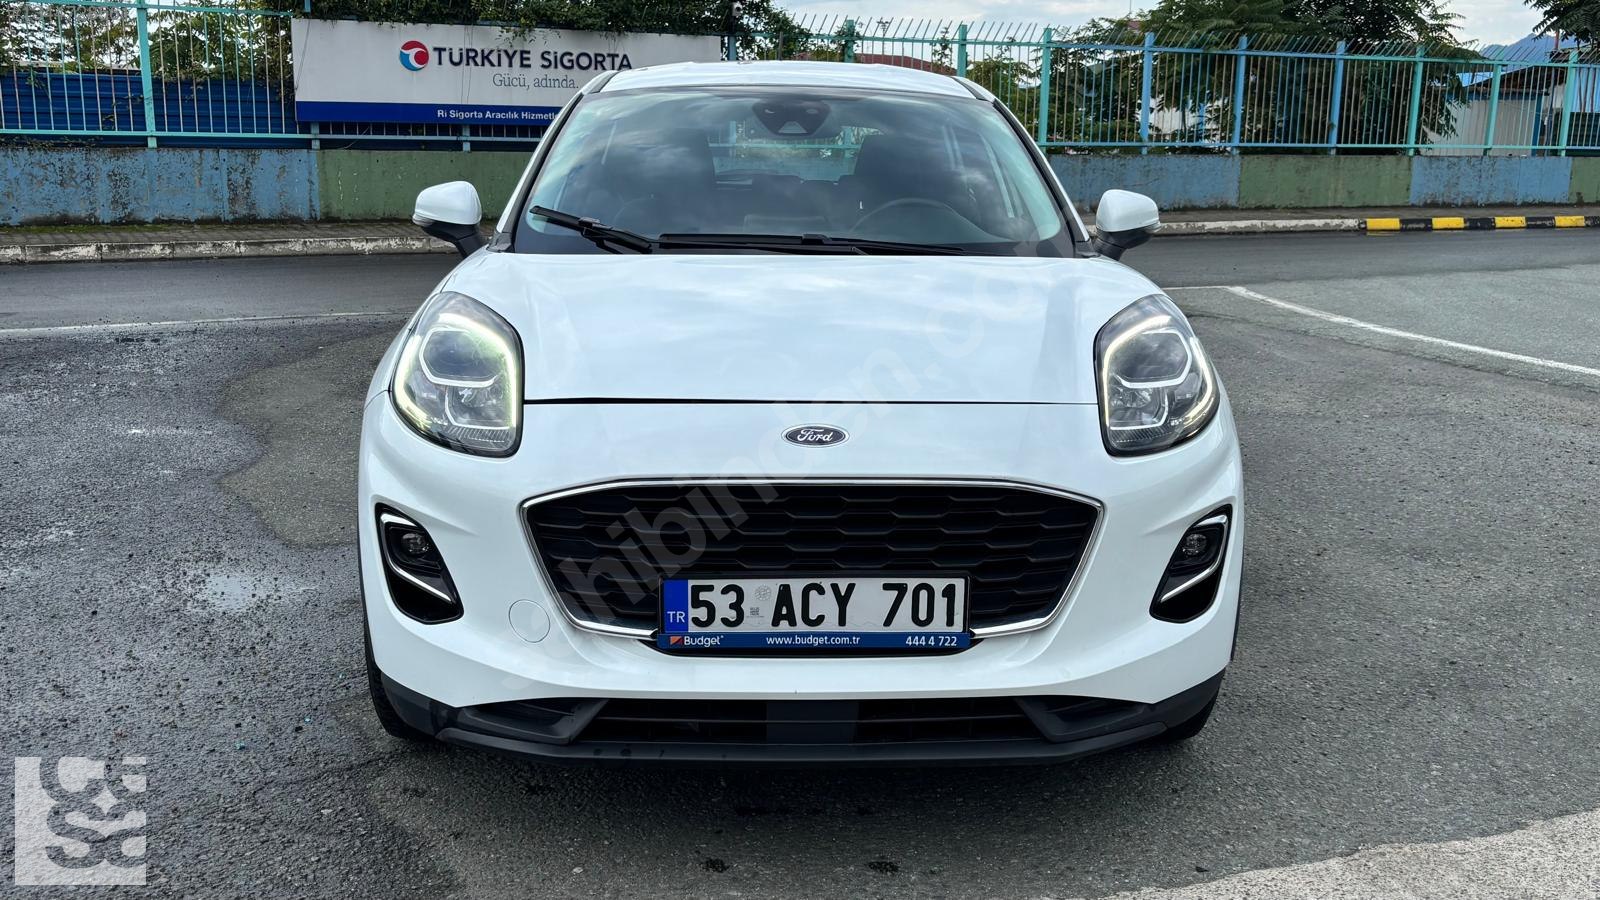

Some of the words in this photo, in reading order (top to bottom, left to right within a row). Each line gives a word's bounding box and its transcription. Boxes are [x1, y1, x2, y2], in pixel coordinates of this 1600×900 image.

[492, 73, 530, 91] Gücü,
[533, 74, 579, 89] adında.
[437, 109, 447, 118] Ri
[449, 109, 483, 120] Sigorta
[485, 111, 519, 119] Aracılık
[797, 428, 834, 442] Ford
[690, 584, 745, 628] 53
[771, 583, 856, 628] ACY
[882, 583, 957, 628] 701
[667, 611, 686, 623] TR
[684, 635, 721, 648] Budget
[766, 635, 861, 647] www.budget.com.tr
[905, 635, 926, 647] 444
[938, 635, 958, 647] 722
